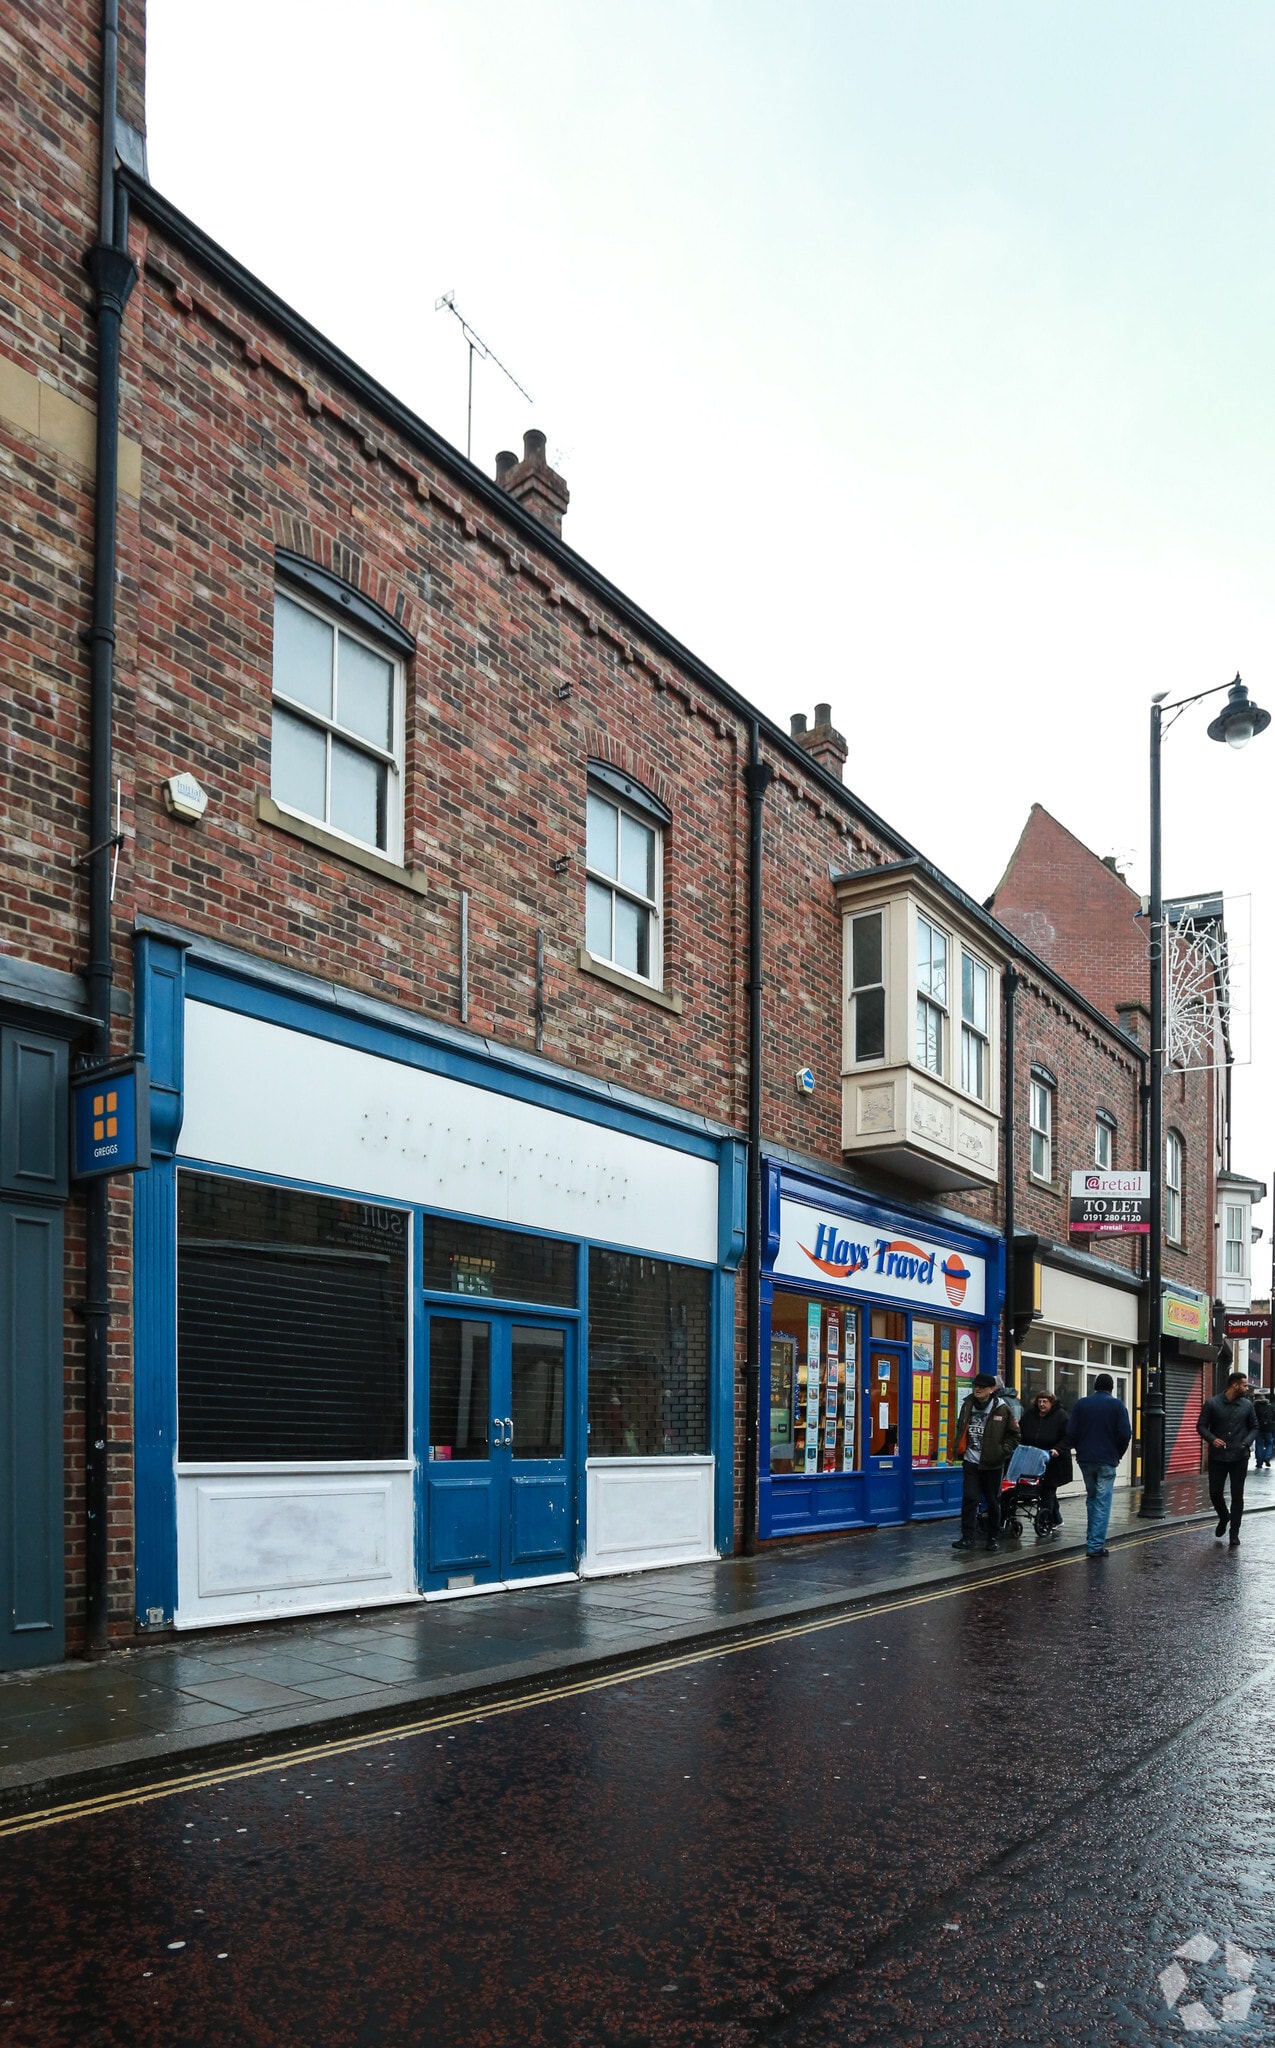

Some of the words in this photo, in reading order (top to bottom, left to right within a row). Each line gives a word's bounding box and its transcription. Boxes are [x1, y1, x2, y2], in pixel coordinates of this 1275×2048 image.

[94, 1144, 118, 1158] GREGGS
[1084, 1200, 1107, 1213] TO
[1111, 1200, 1142, 1213] LET
[1121, 1214, 1142, 1222] 4120
[814, 1223, 870, 1276] Hays
[875, 1238, 936, 1285] Travel
[1228, 1319, 1269, 1328] Sainsbury's
[960, 1352, 971, 1363] £49
